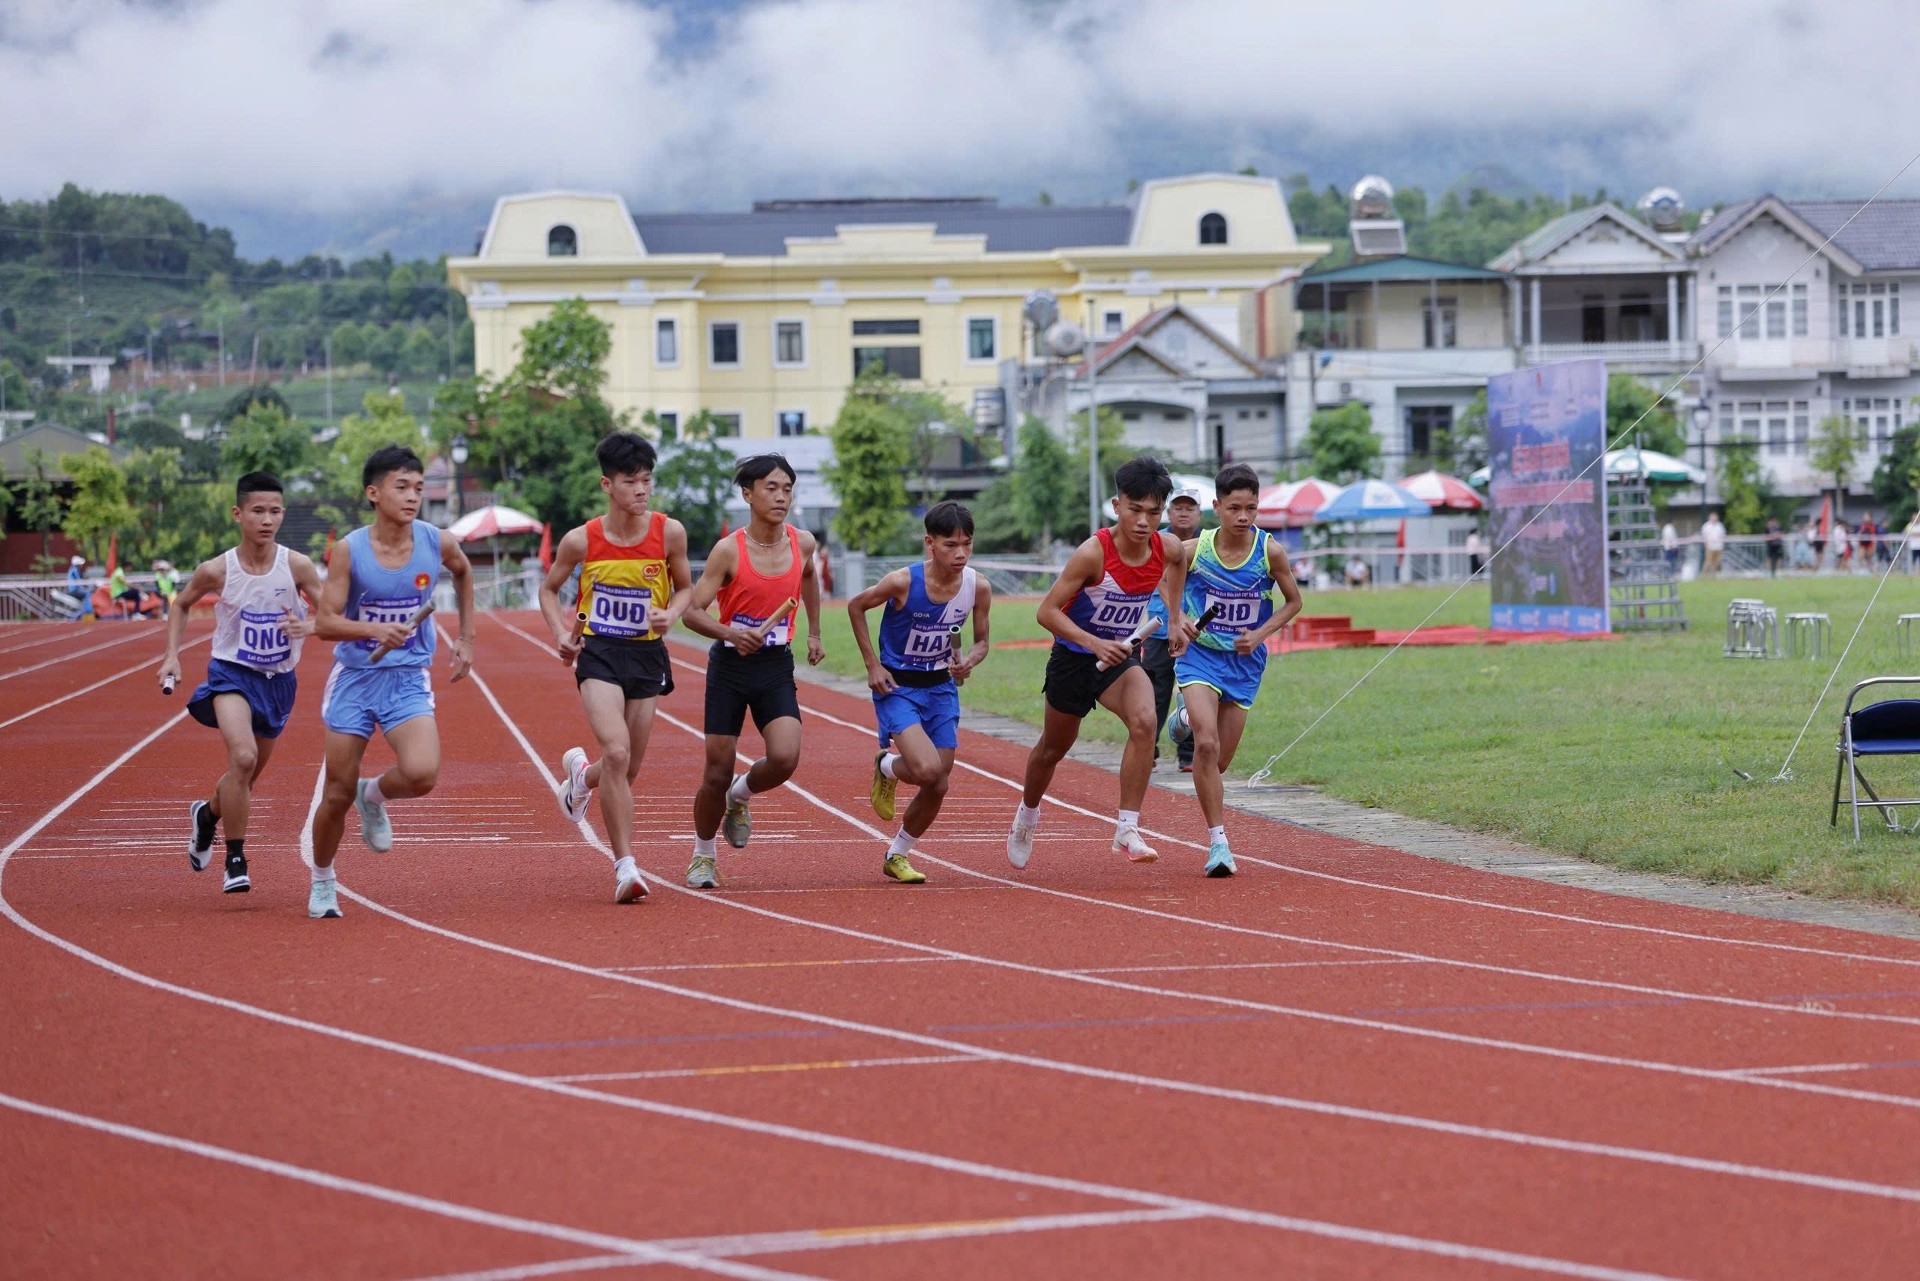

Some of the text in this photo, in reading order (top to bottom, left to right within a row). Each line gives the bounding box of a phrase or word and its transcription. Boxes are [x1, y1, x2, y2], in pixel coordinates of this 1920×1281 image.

[596, 597, 645, 624] QUĐ
[1214, 601, 1250, 621] BIĐ
[245, 627, 289, 650] QNG
